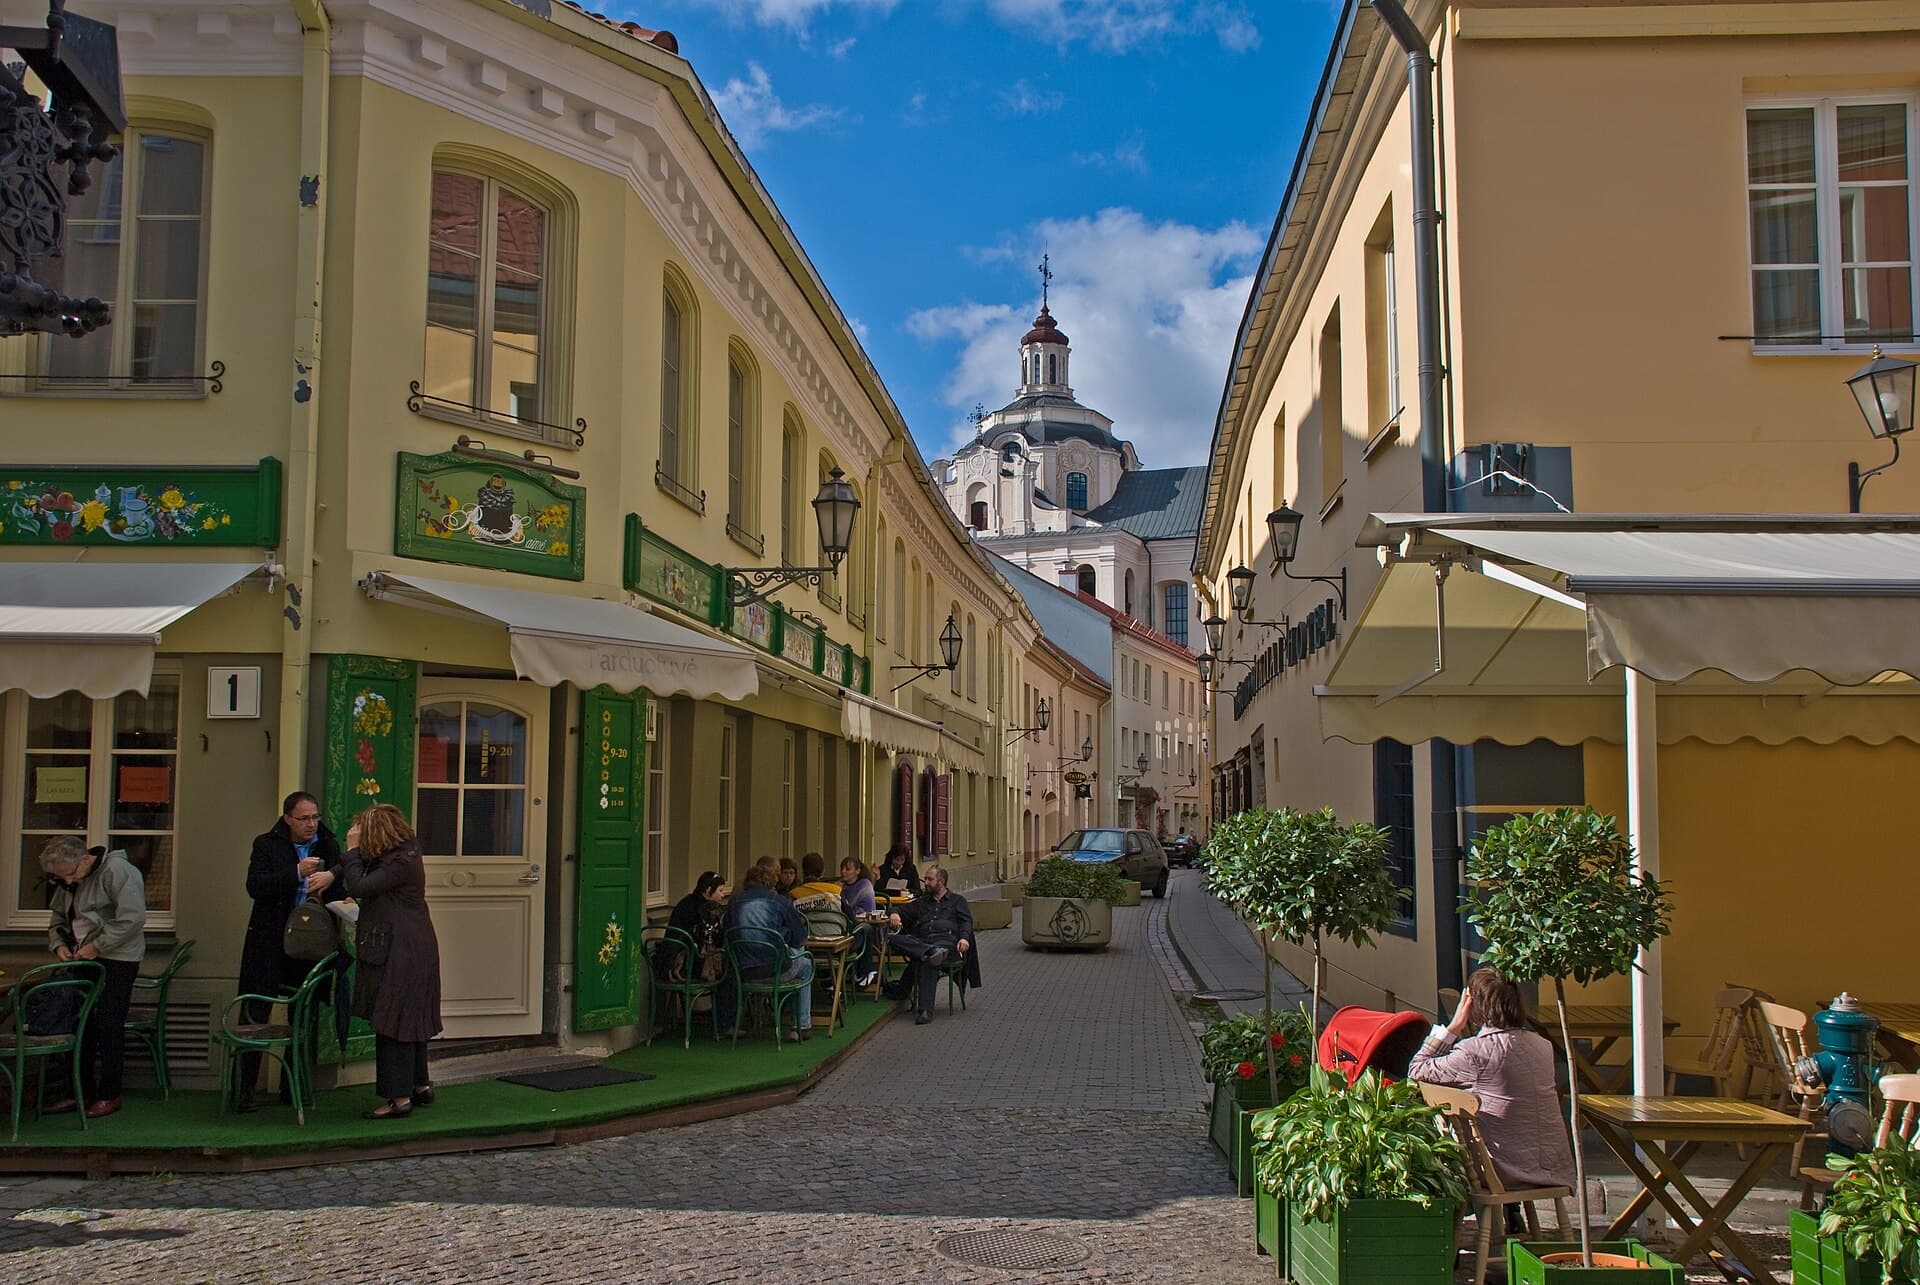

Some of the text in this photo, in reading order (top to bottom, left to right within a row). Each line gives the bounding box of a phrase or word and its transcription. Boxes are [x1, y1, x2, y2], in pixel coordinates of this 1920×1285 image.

[227, 673, 239, 712] 1
[488, 745, 513, 757] 9-20
[610, 747, 628, 758] 9-20
